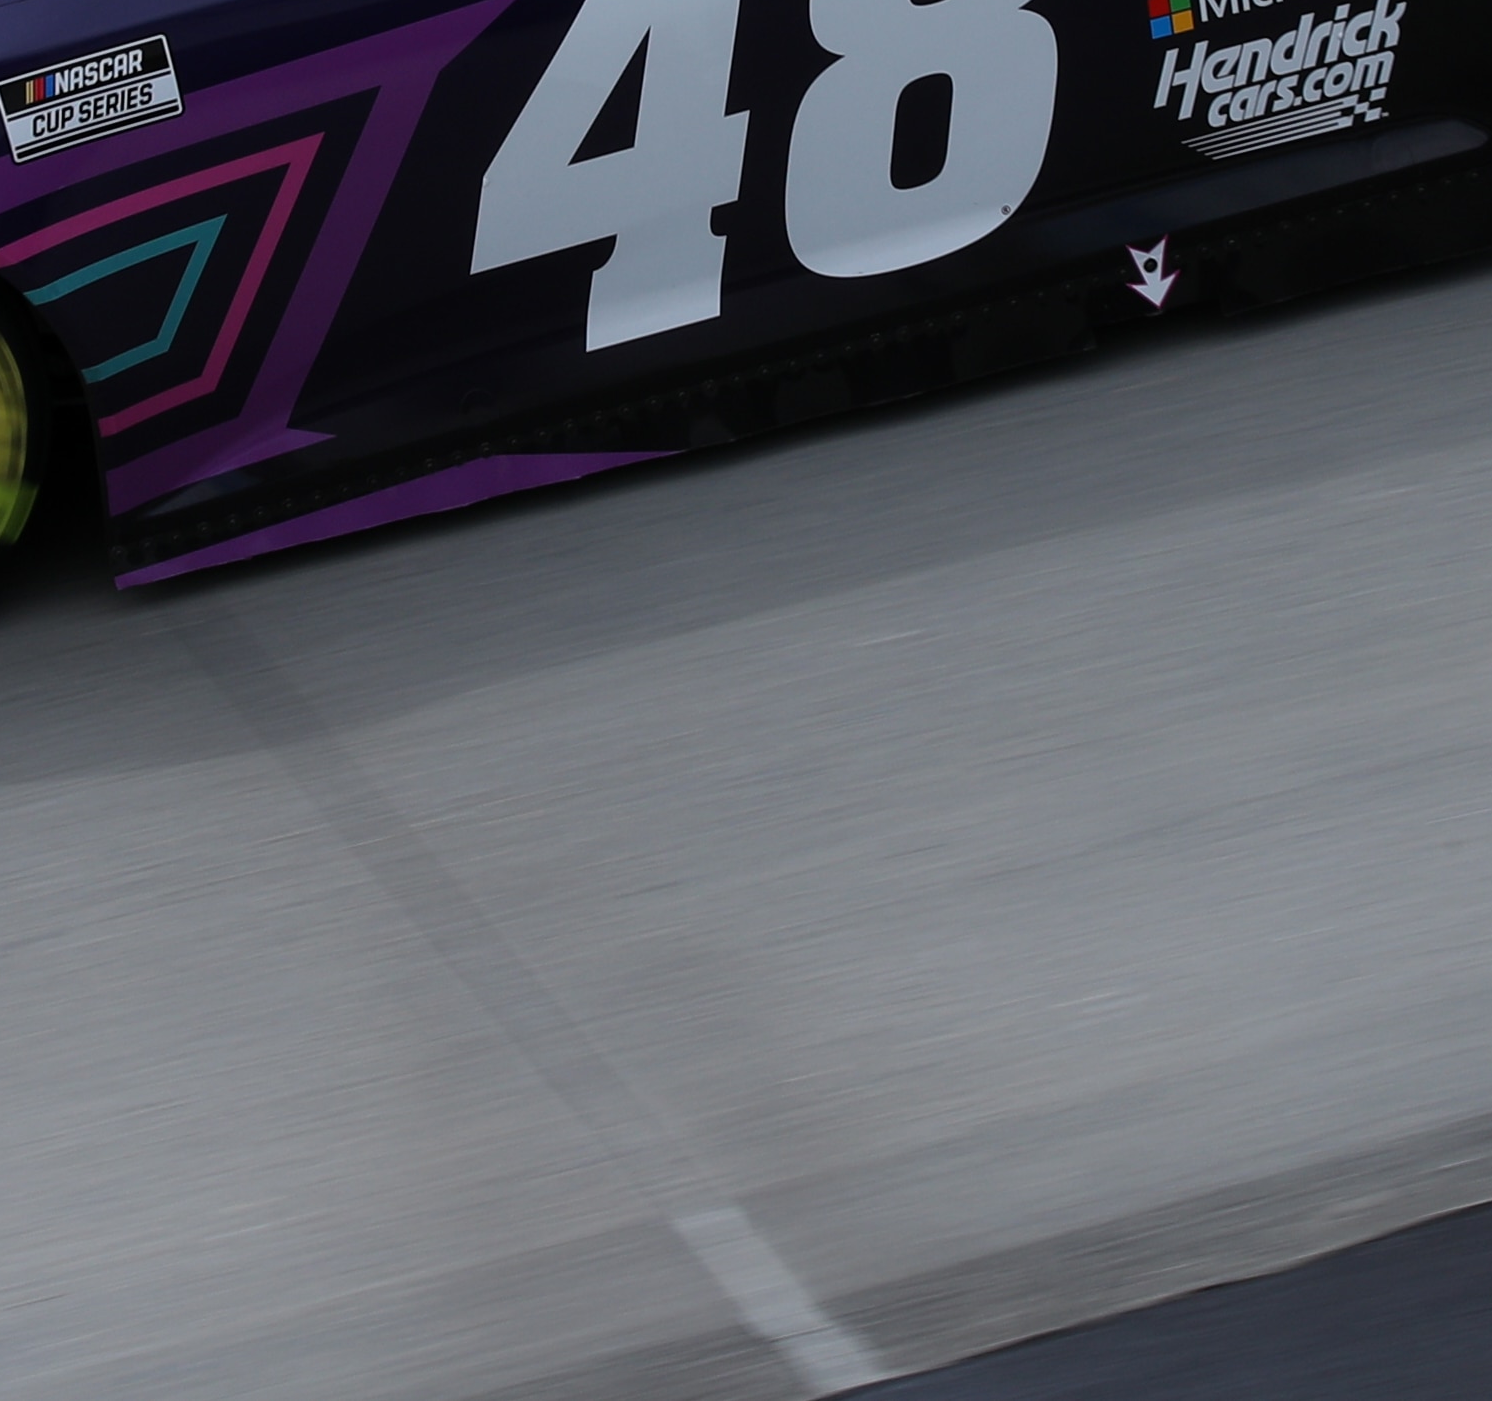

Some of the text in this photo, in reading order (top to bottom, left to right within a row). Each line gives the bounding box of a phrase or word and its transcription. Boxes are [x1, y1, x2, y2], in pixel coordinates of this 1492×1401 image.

[54, 48, 143, 96] NASCAR
[1207, 51, 1396, 128] cars.com
[32, 82, 154, 138] CUP SERIES
